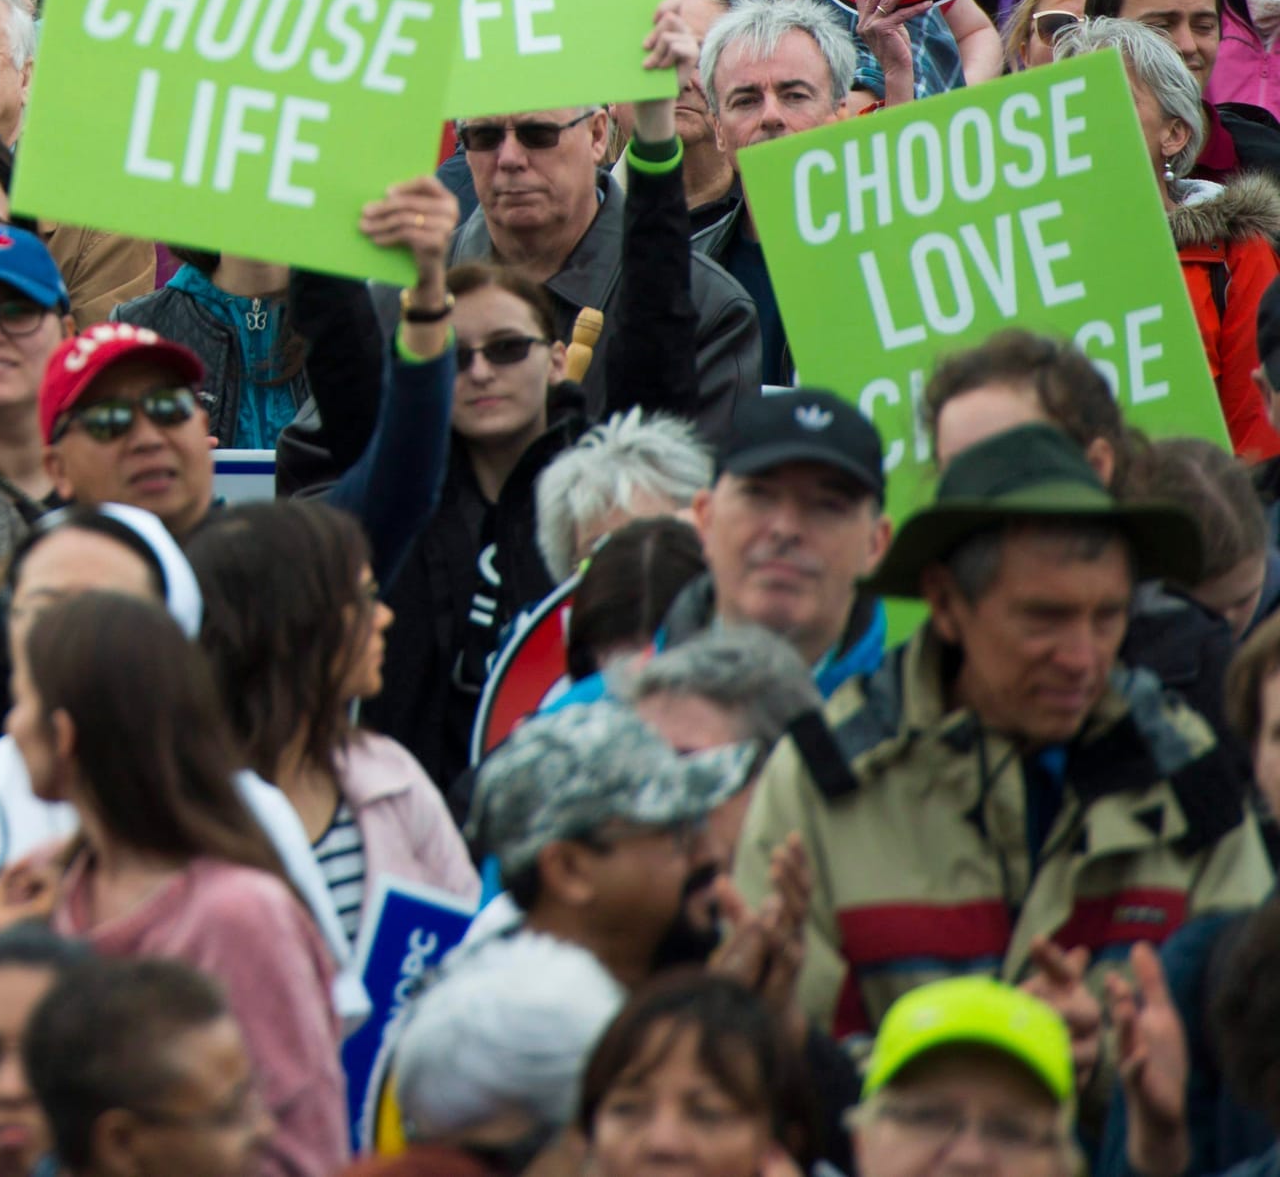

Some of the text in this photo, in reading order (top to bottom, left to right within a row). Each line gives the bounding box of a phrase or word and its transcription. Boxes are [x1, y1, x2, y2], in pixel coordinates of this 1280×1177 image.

[123, 67, 331, 209] LIFE
[792, 75, 1094, 245] CHOOSE
[857, 201, 1088, 351] LOVE
